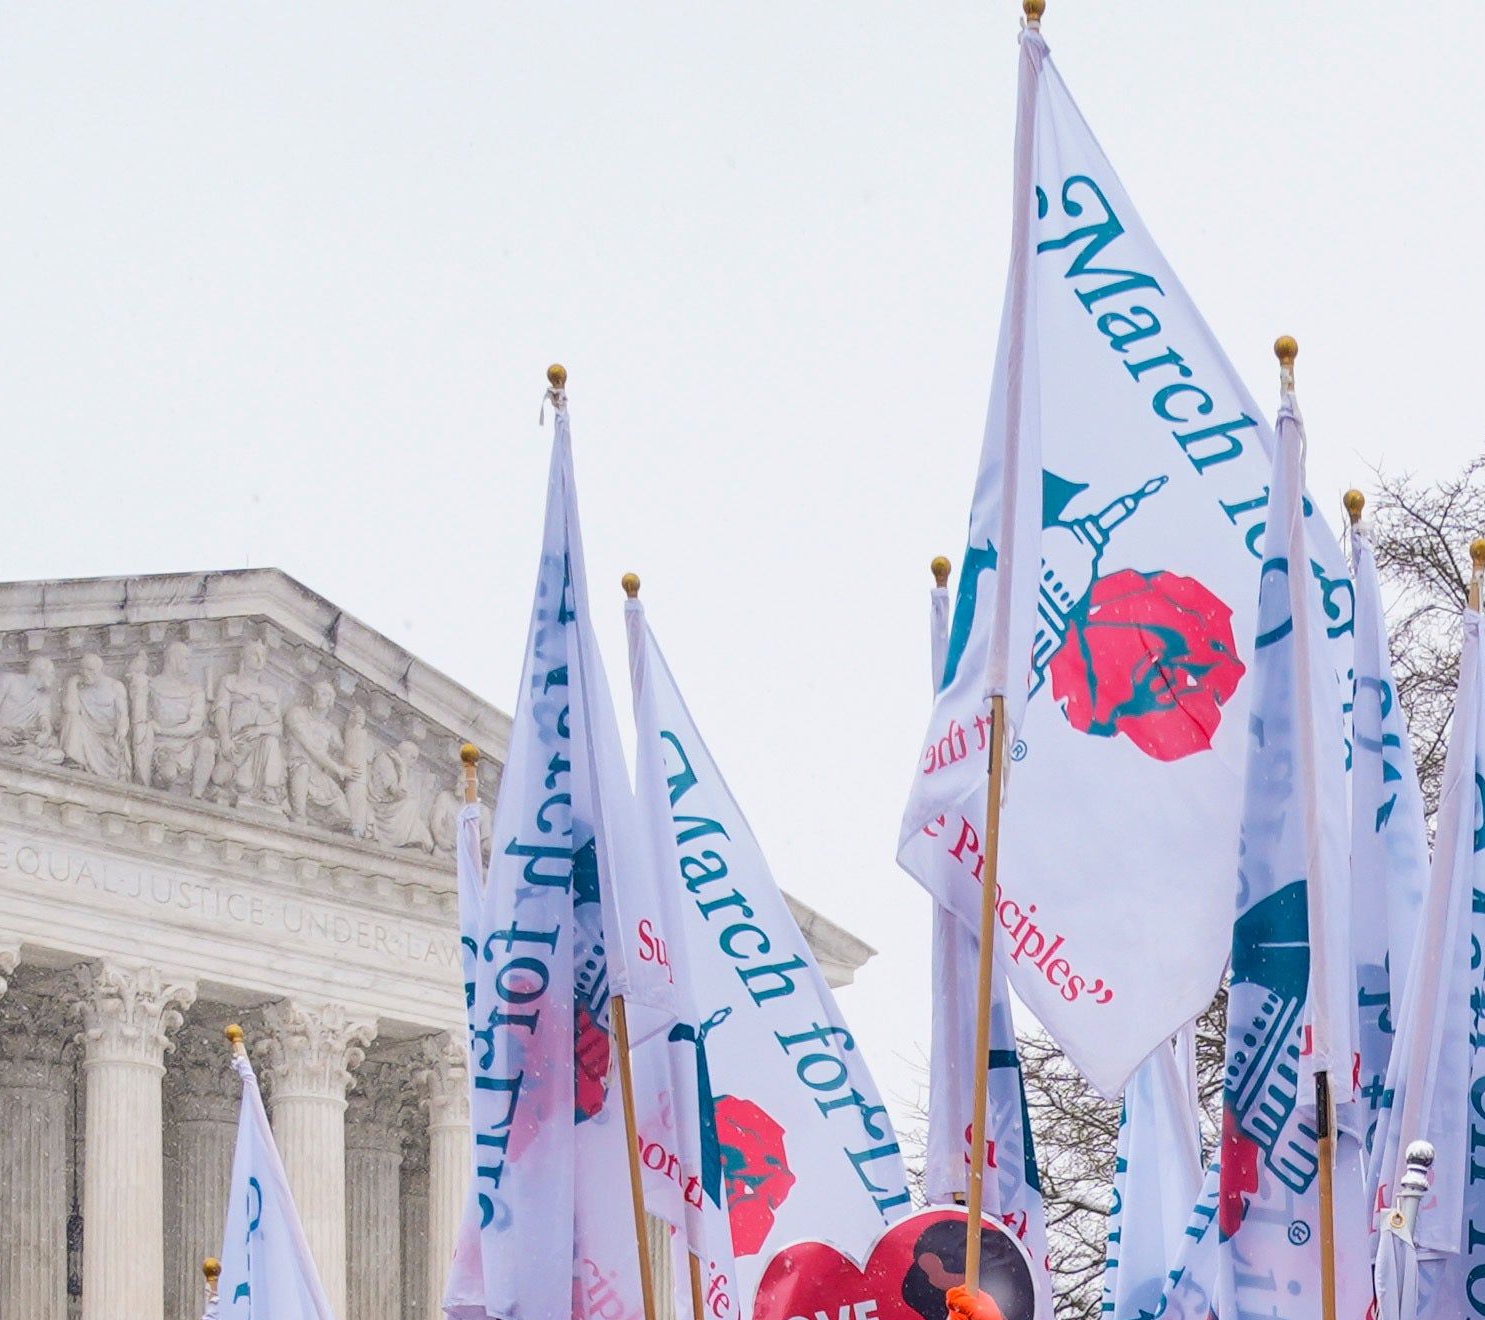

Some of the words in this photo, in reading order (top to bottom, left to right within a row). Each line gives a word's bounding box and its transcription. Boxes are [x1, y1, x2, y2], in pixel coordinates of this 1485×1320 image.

[1032, 176, 1259, 477] March
[125, 872, 265, 928] JUSTICE
[282, 906, 399, 956] UNDER
[773, 1021, 855, 1120] for
